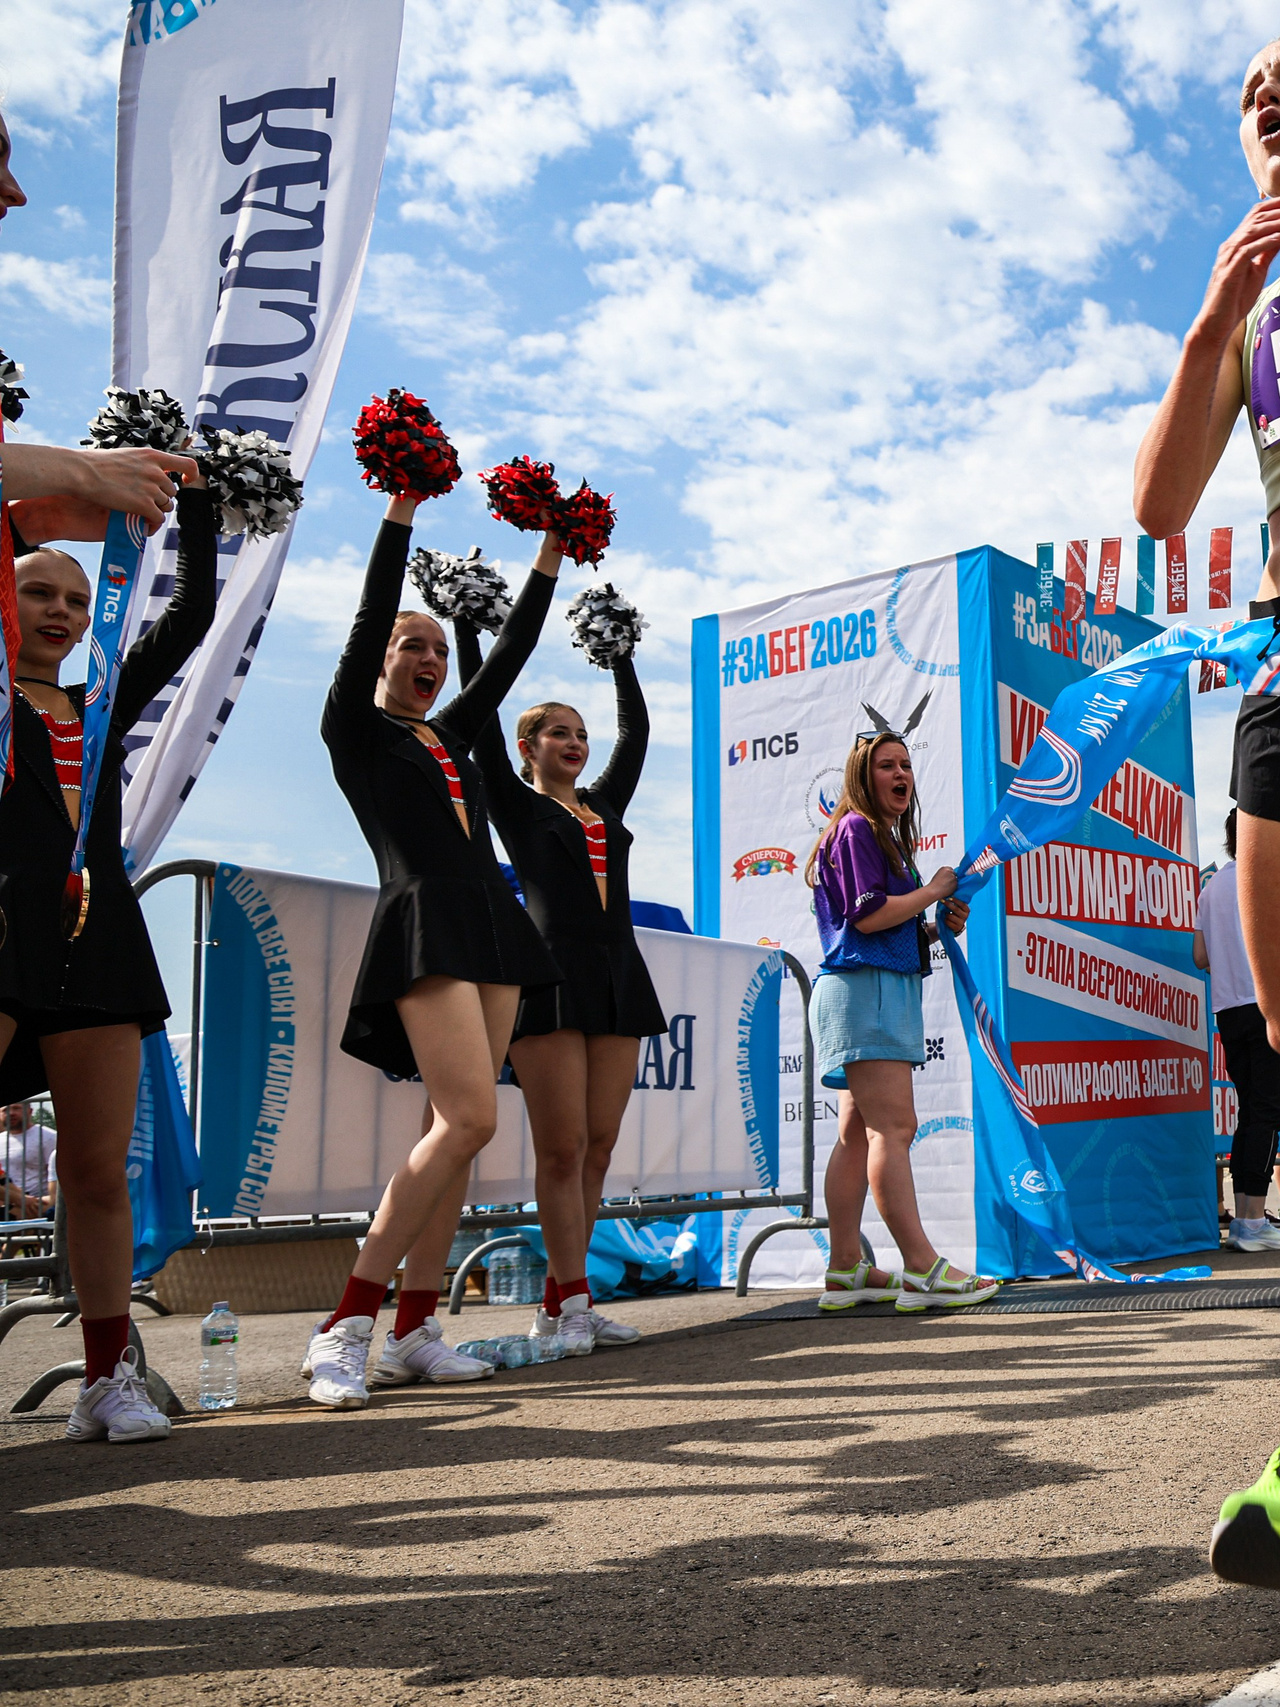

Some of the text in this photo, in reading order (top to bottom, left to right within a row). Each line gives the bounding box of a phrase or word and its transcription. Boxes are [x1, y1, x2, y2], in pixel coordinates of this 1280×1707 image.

[103, 588, 122, 623] ПСБ
[721, 609, 877, 687] #ЗАБЕГ2026
[752, 732, 799, 761] ПСБ
[741, 850, 788, 866] СУПЕРСУП
[1010, 844, 1196, 929] ПОЛУМАРАФОН
[226, 871, 295, 1025] ПОКА ВСЕ СПЯТ
[739, 974, 765, 1022] РАМКИ
[1025, 932, 1075, 989] ЭТАПА
[1078, 950, 1199, 1031] ВСЕРОССИЙСКОГО
[738, 1024, 752, 1043] ЗА
[1021, 1060, 1140, 1107] ПОЛУМАРАФОНА
[1142, 1057, 1204, 1098] ЗАБЕГ.РФ
[244, 1043, 295, 1177] КИЛОМЕТРЫ
